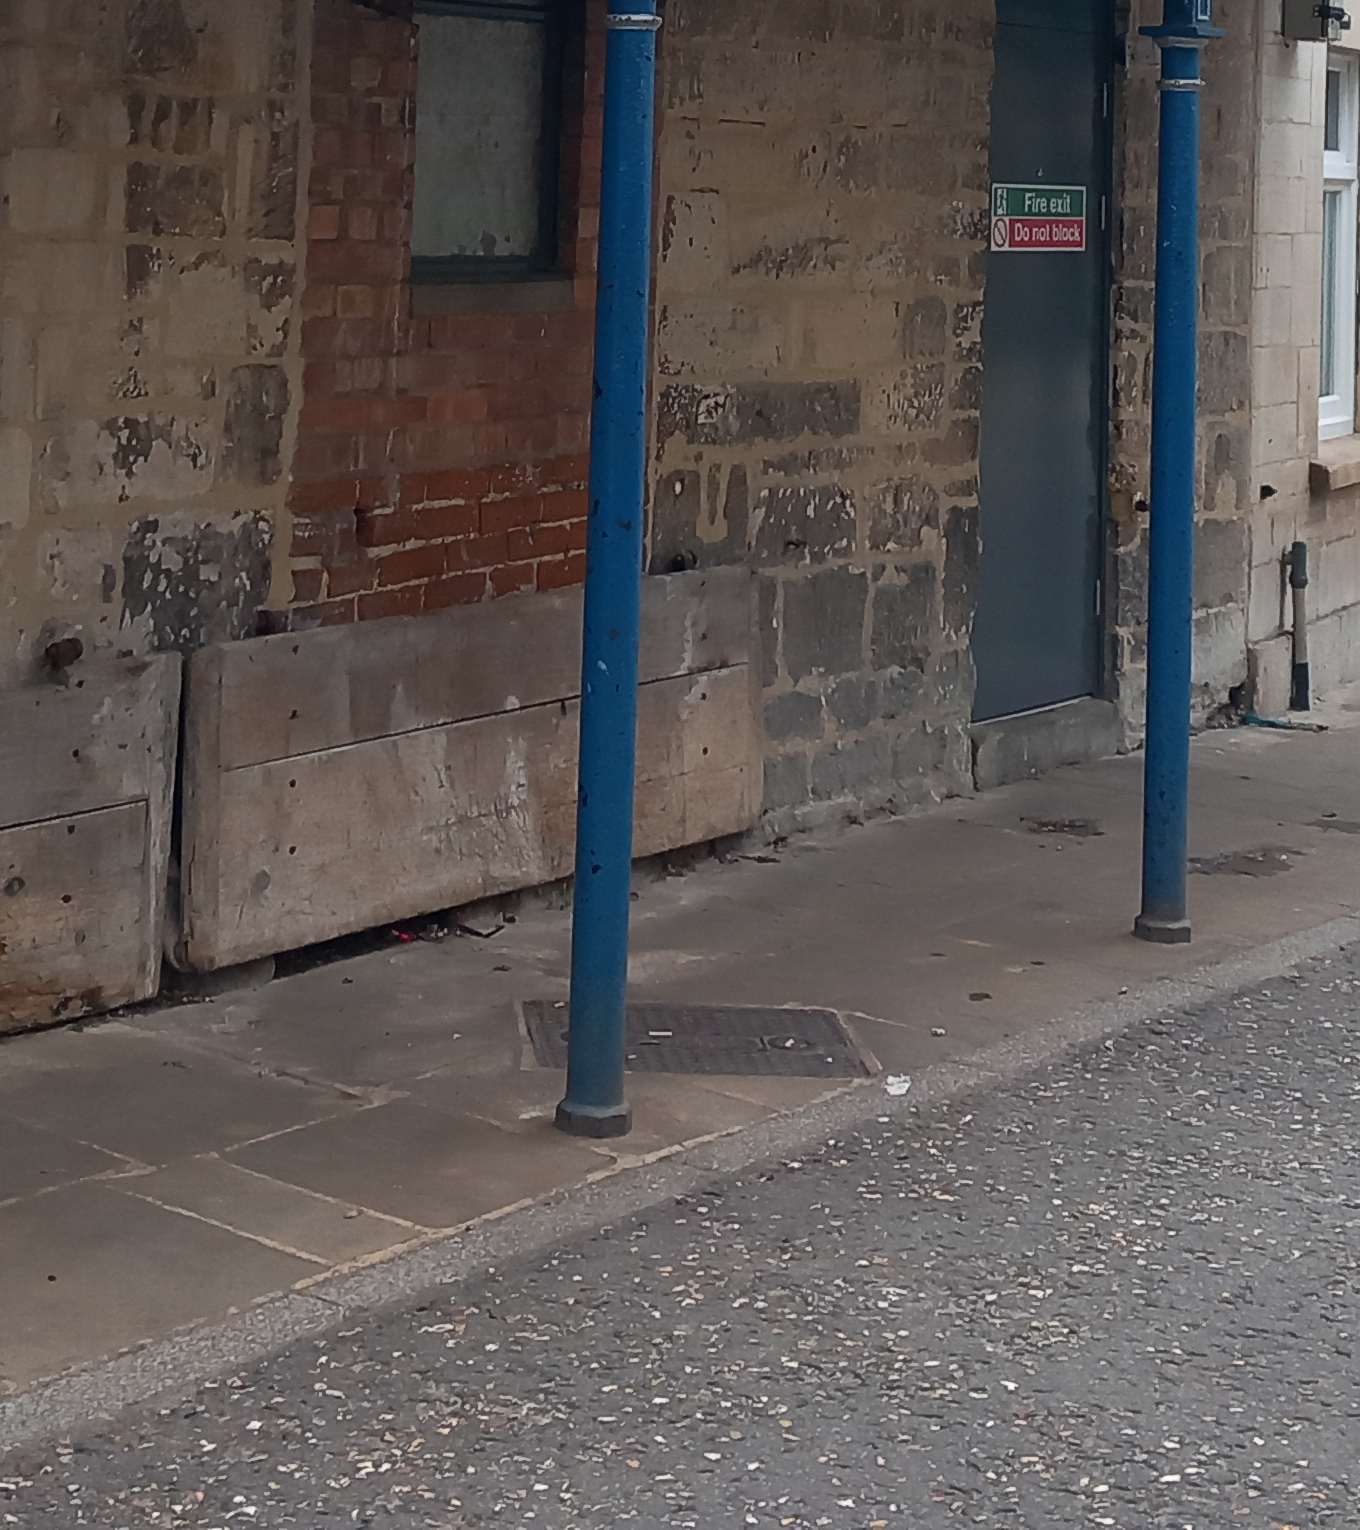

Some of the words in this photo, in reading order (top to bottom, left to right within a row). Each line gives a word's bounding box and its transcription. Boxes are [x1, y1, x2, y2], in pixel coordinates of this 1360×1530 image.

[1024, 192, 1048, 213] Fire
[1049, 192, 1071, 213] exit
[1014, 223, 1030, 241] Do
[1031, 224, 1050, 241] not
[1051, 223, 1081, 241] block
